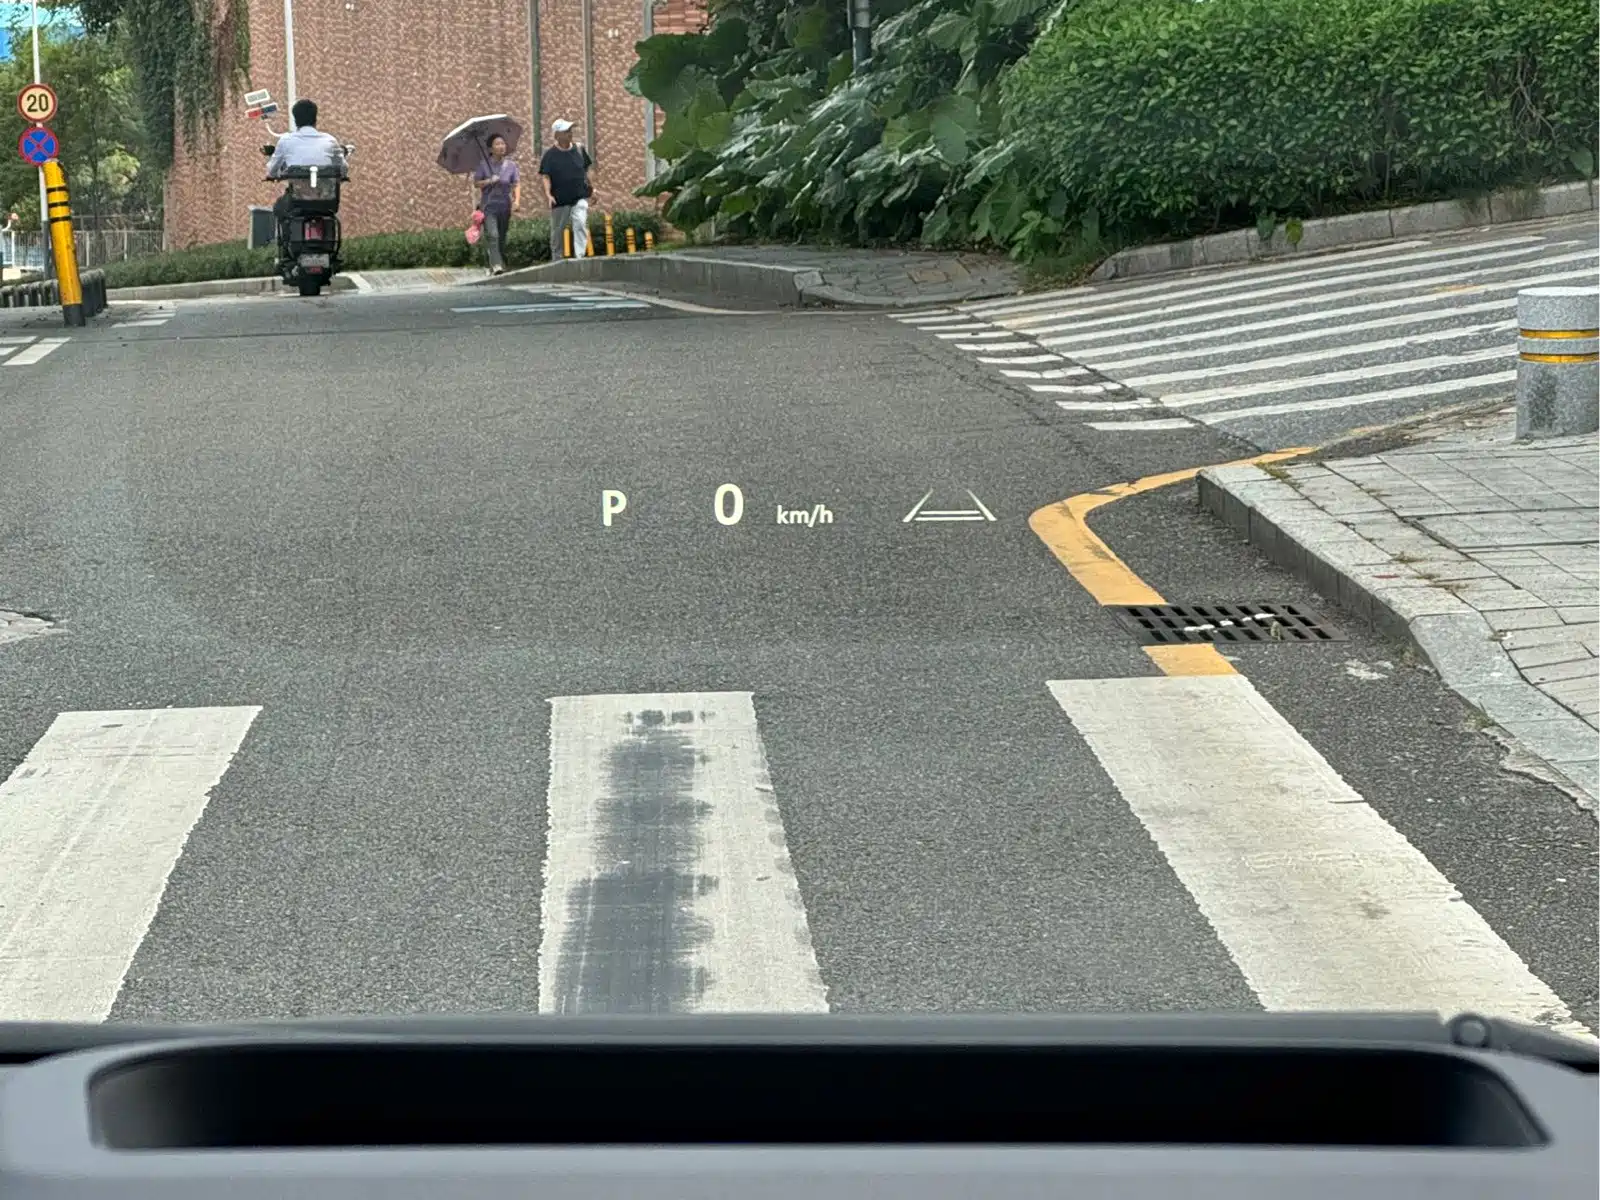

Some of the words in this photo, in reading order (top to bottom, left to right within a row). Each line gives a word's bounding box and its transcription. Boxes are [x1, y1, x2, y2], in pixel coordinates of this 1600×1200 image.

[27, 93, 49, 112] 20
[602, 490, 627, 526] P
[714, 484, 744, 526] 0
[776, 505, 833, 528] km/h
